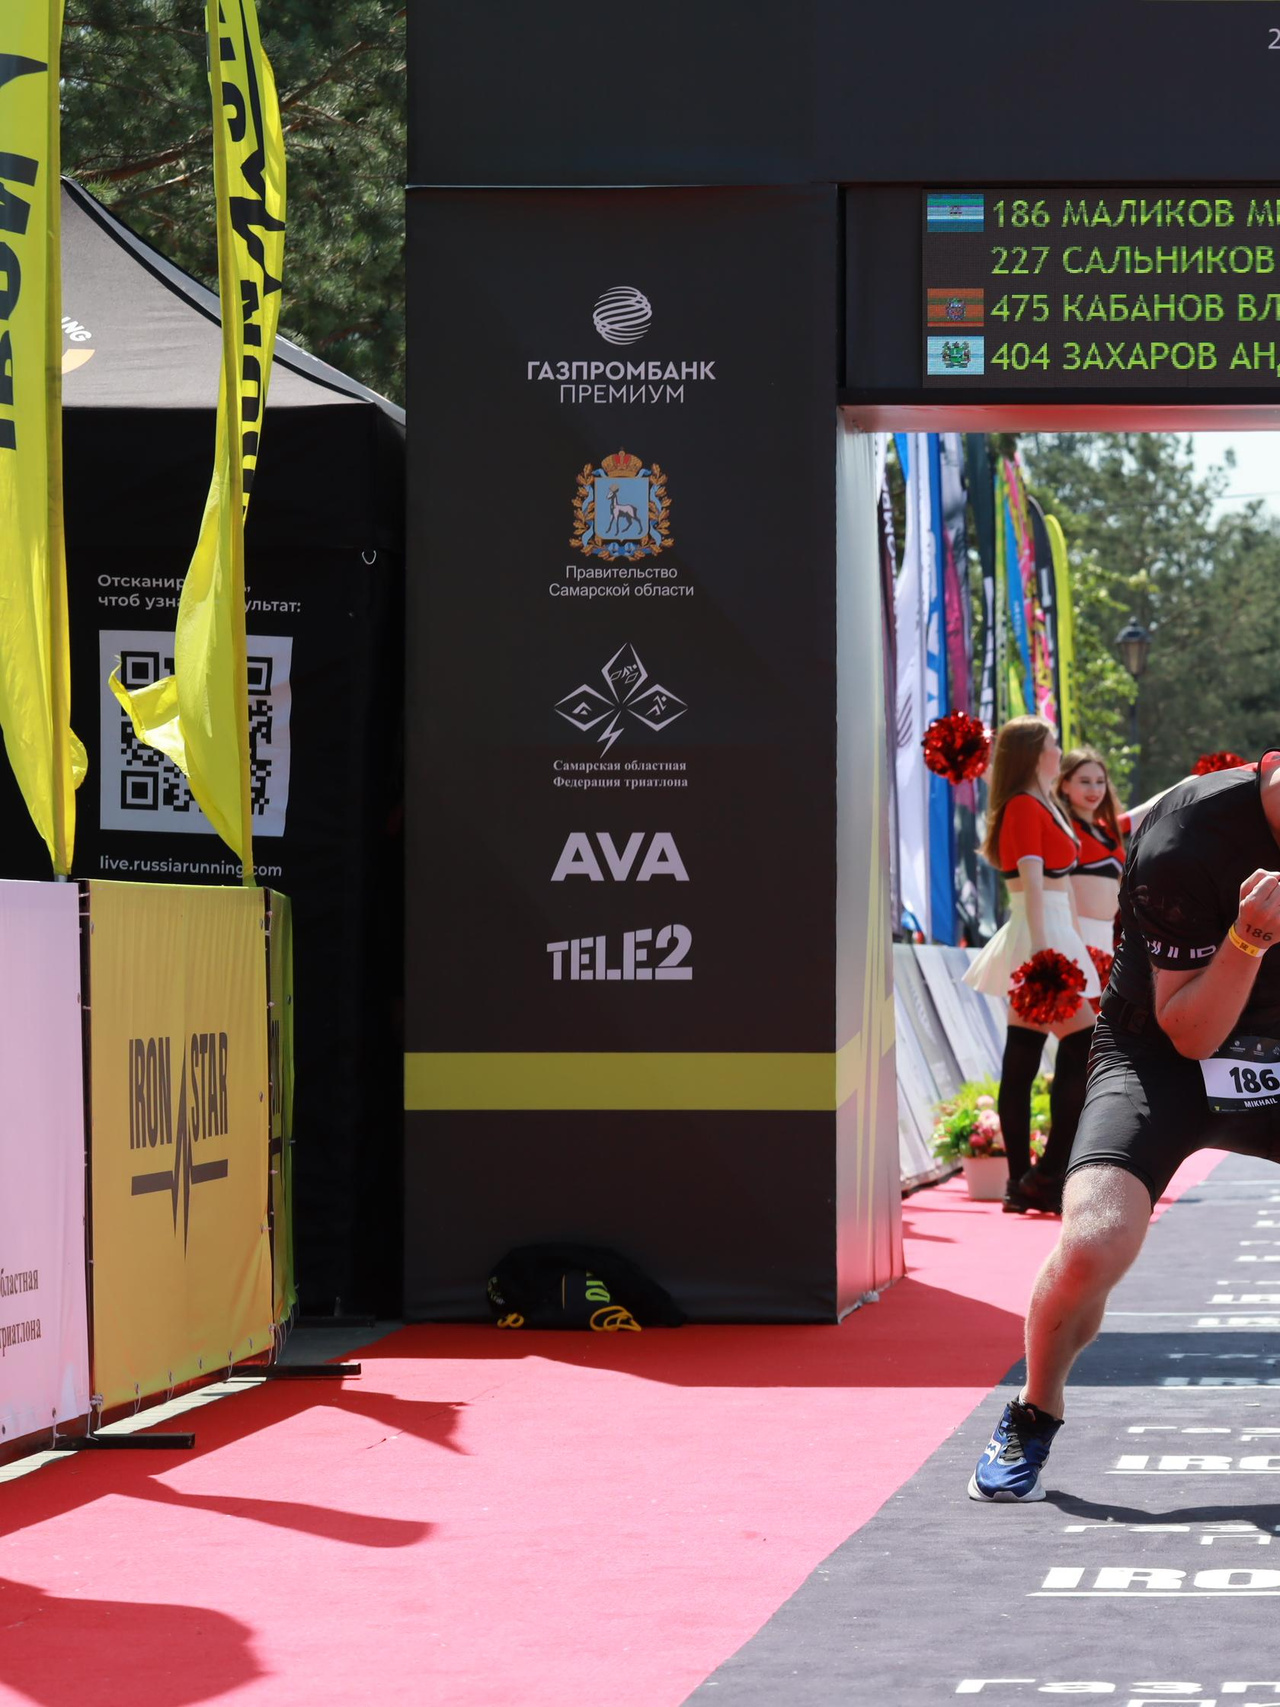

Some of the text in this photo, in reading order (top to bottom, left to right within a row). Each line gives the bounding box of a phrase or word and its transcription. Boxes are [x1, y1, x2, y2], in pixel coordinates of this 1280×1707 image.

[992, 200, 1050, 227] 186
[1062, 199, 1234, 227] МАЛИКОВ
[991, 246, 1050, 274] 227
[1063, 246, 1275, 274] САЛЬНИКОВ
[991, 294, 1050, 322] 475
[1063, 294, 1224, 322] КАБАНОВ
[991, 342, 1050, 370] 404
[1063, 341, 1217, 371] ЗАХАРОВ
[527, 361, 716, 380] ГАЗПРОМБАНК
[560, 384, 684, 404] ПРЕМИУМ
[566, 565, 678, 581] Правительство
[98, 593, 140, 607] чтоб
[549, 583, 694, 599] Самарской области
[553, 760, 687, 773] Самарская областная
[553, 777, 688, 790] Федерация триатлона
[100, 856, 282, 878] live.russiarunningcom
[550, 832, 690, 881] AVA
[1244, 923, 1274, 942] 186
[547, 924, 693, 980] TELE2
[129, 1036, 172, 1149] IRON
[191, 1032, 228, 1143] STAR
[1229, 1066, 1280, 1094] 186
[1243, 1097, 1279, 1109] MIKHAIL
